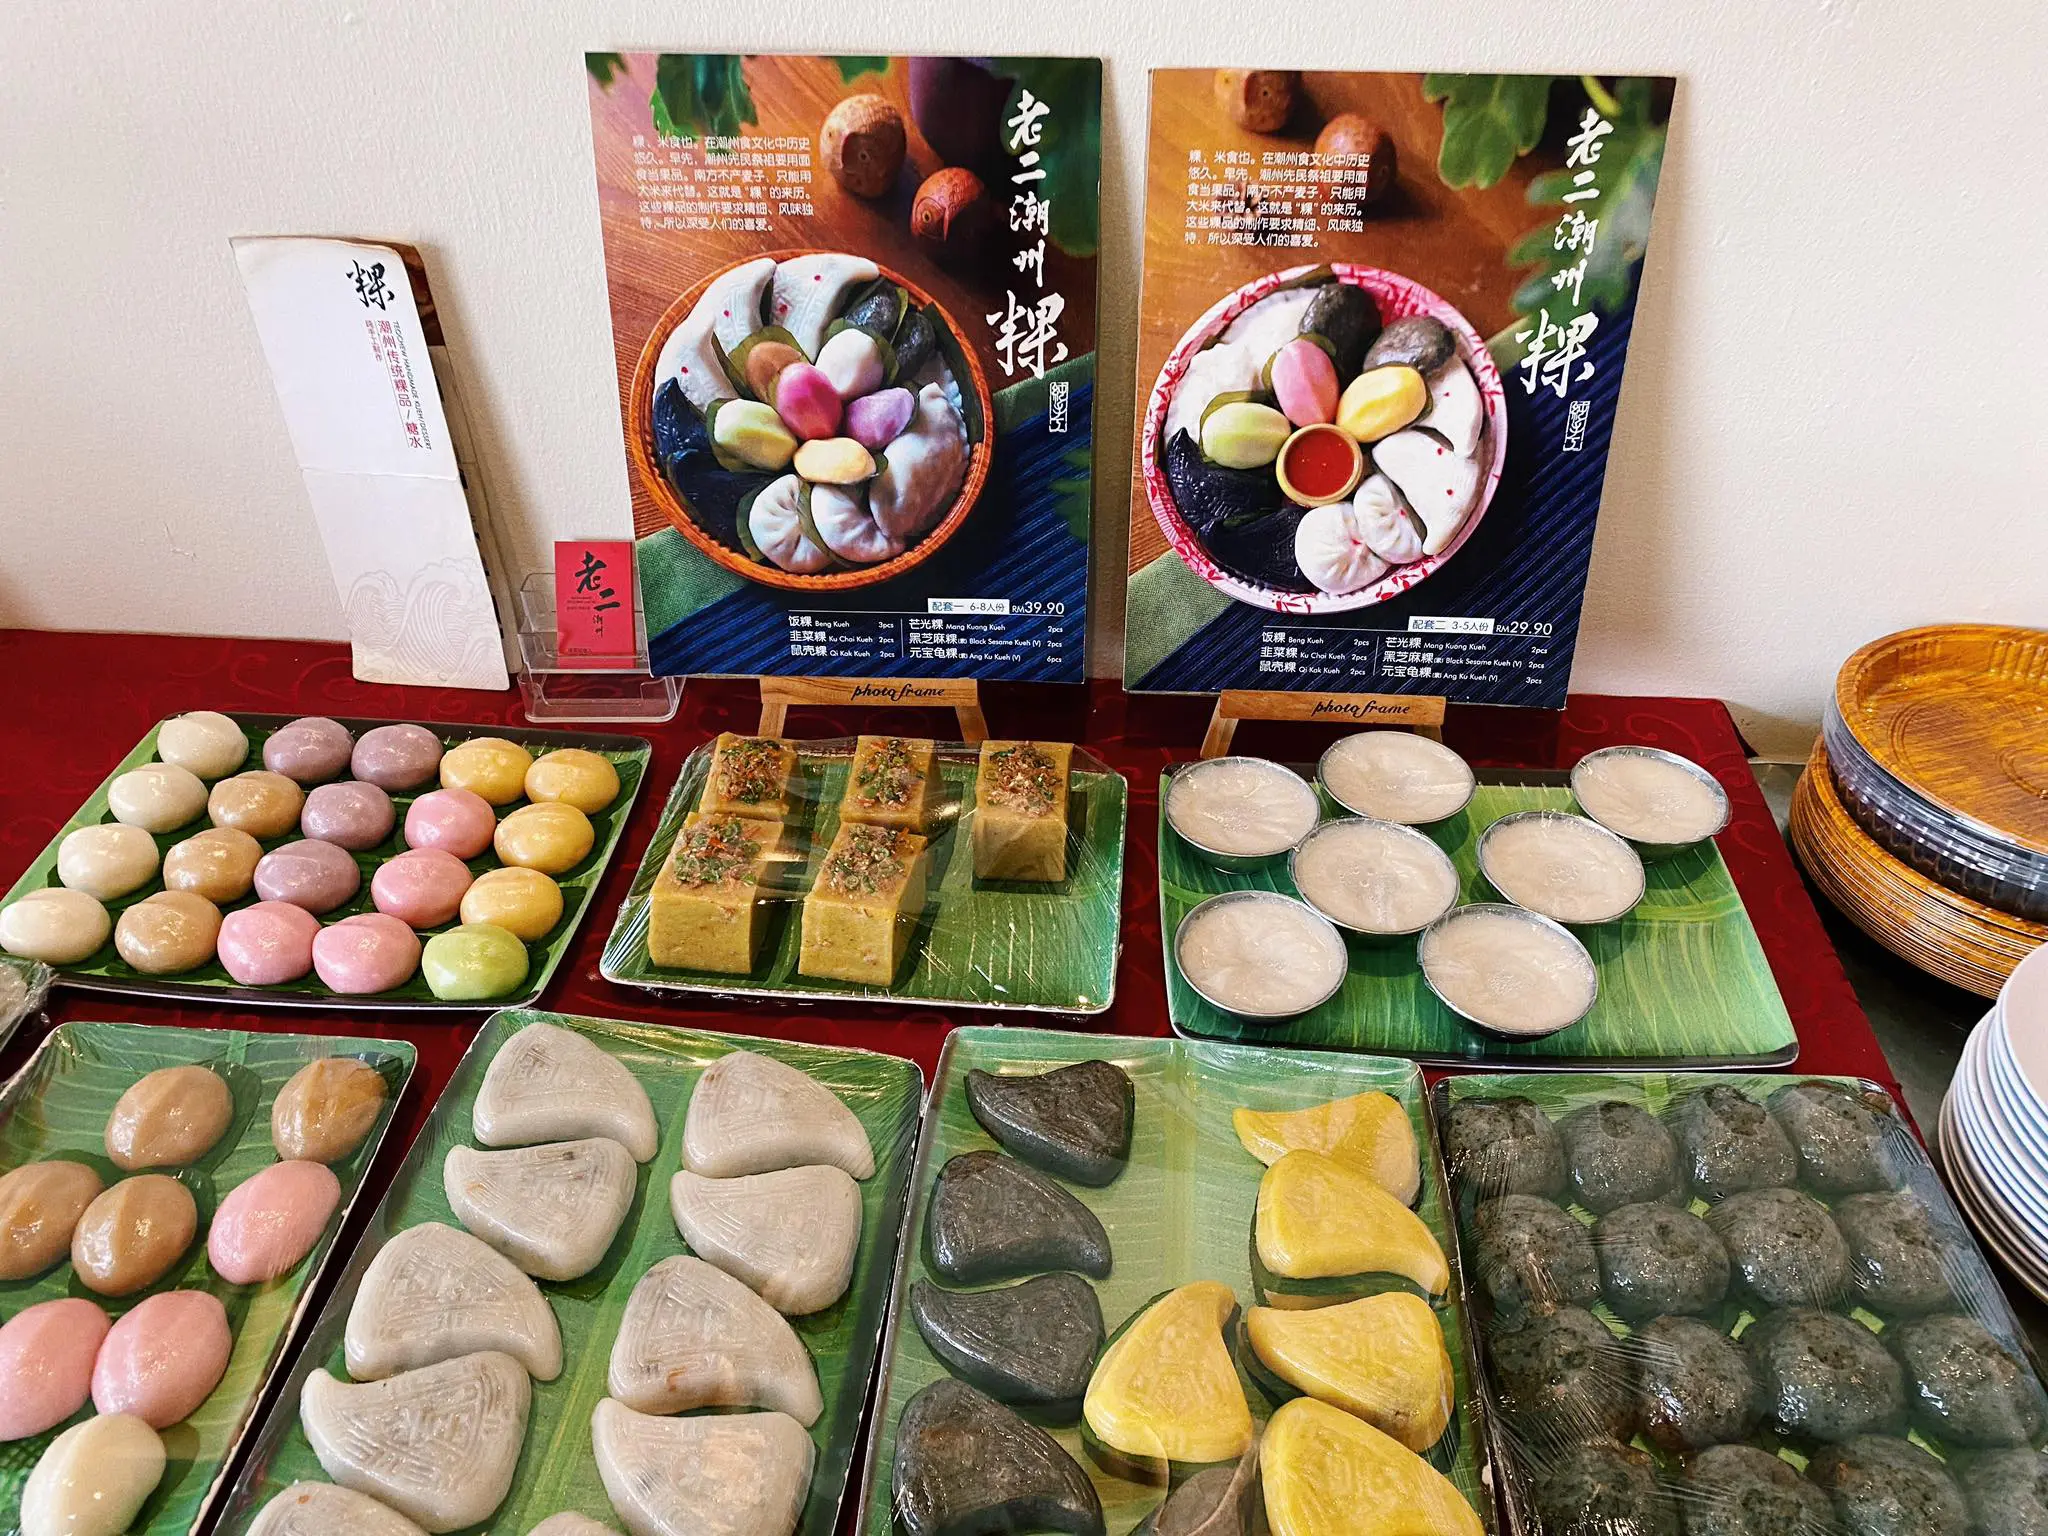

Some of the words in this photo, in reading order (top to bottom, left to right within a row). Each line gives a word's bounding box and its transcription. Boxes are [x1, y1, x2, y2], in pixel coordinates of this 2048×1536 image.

[403, 358, 419, 400] HANDMADE
[970, 603, 1005, 612] 6-8人份
[788, 615, 812, 628] 饭粿
[815, 621, 831, 629] Beng
[909, 618, 943, 630] 芒光粿
[946, 624, 965, 632] Mang
[966, 624, 988, 632] Kuang
[1048, 626, 1063, 634] 2pcs
[1451, 621, 1489, 631] 3-5人份
[790, 630, 826, 643] 韭菜粿
[988, 638, 1013, 646] Sesame
[1032, 640, 1041, 648] (V)
[1262, 631, 1286, 644] 饭粿
[1289, 637, 1305, 645] Beng
[1354, 639, 1370, 647] 2pcs
[1260, 646, 1298, 659] 韭菜粿
[1385, 637, 1422, 649] 芒光粿
[1423, 643, 1444, 651] Mang
[1445, 643, 1468, 651] Kuang
[1531, 647, 1548, 655] 2pcs
[880, 651, 895, 659] 2pcs
[910, 647, 957, 659] 元宝龟粿
[969, 653, 983, 661] Ang
[1012, 654, 1021, 662] (V)
[1047, 656, 1062, 664] 6pcs
[1465, 658, 1491, 666] Sesame
[1493, 659, 1511, 667] Kueh
[1512, 661, 1522, 669] (V)
[1528, 661, 1545, 670] 2pcs
[1323, 667, 1341, 675] Kueh
[1350, 668, 1366, 676] 2pcs
[1381, 665, 1432, 678] 元宝龟粿
[1443, 673, 1458, 681] Ang
[1469, 674, 1487, 682] Kueh
[1489, 675, 1498, 683] (V)
[1526, 677, 1542, 685] 3pcs
[850, 683, 895, 701] photo
[889, 683, 945, 702] frame
[1311, 699, 1361, 717] photo
[1352, 700, 1410, 718] frame
